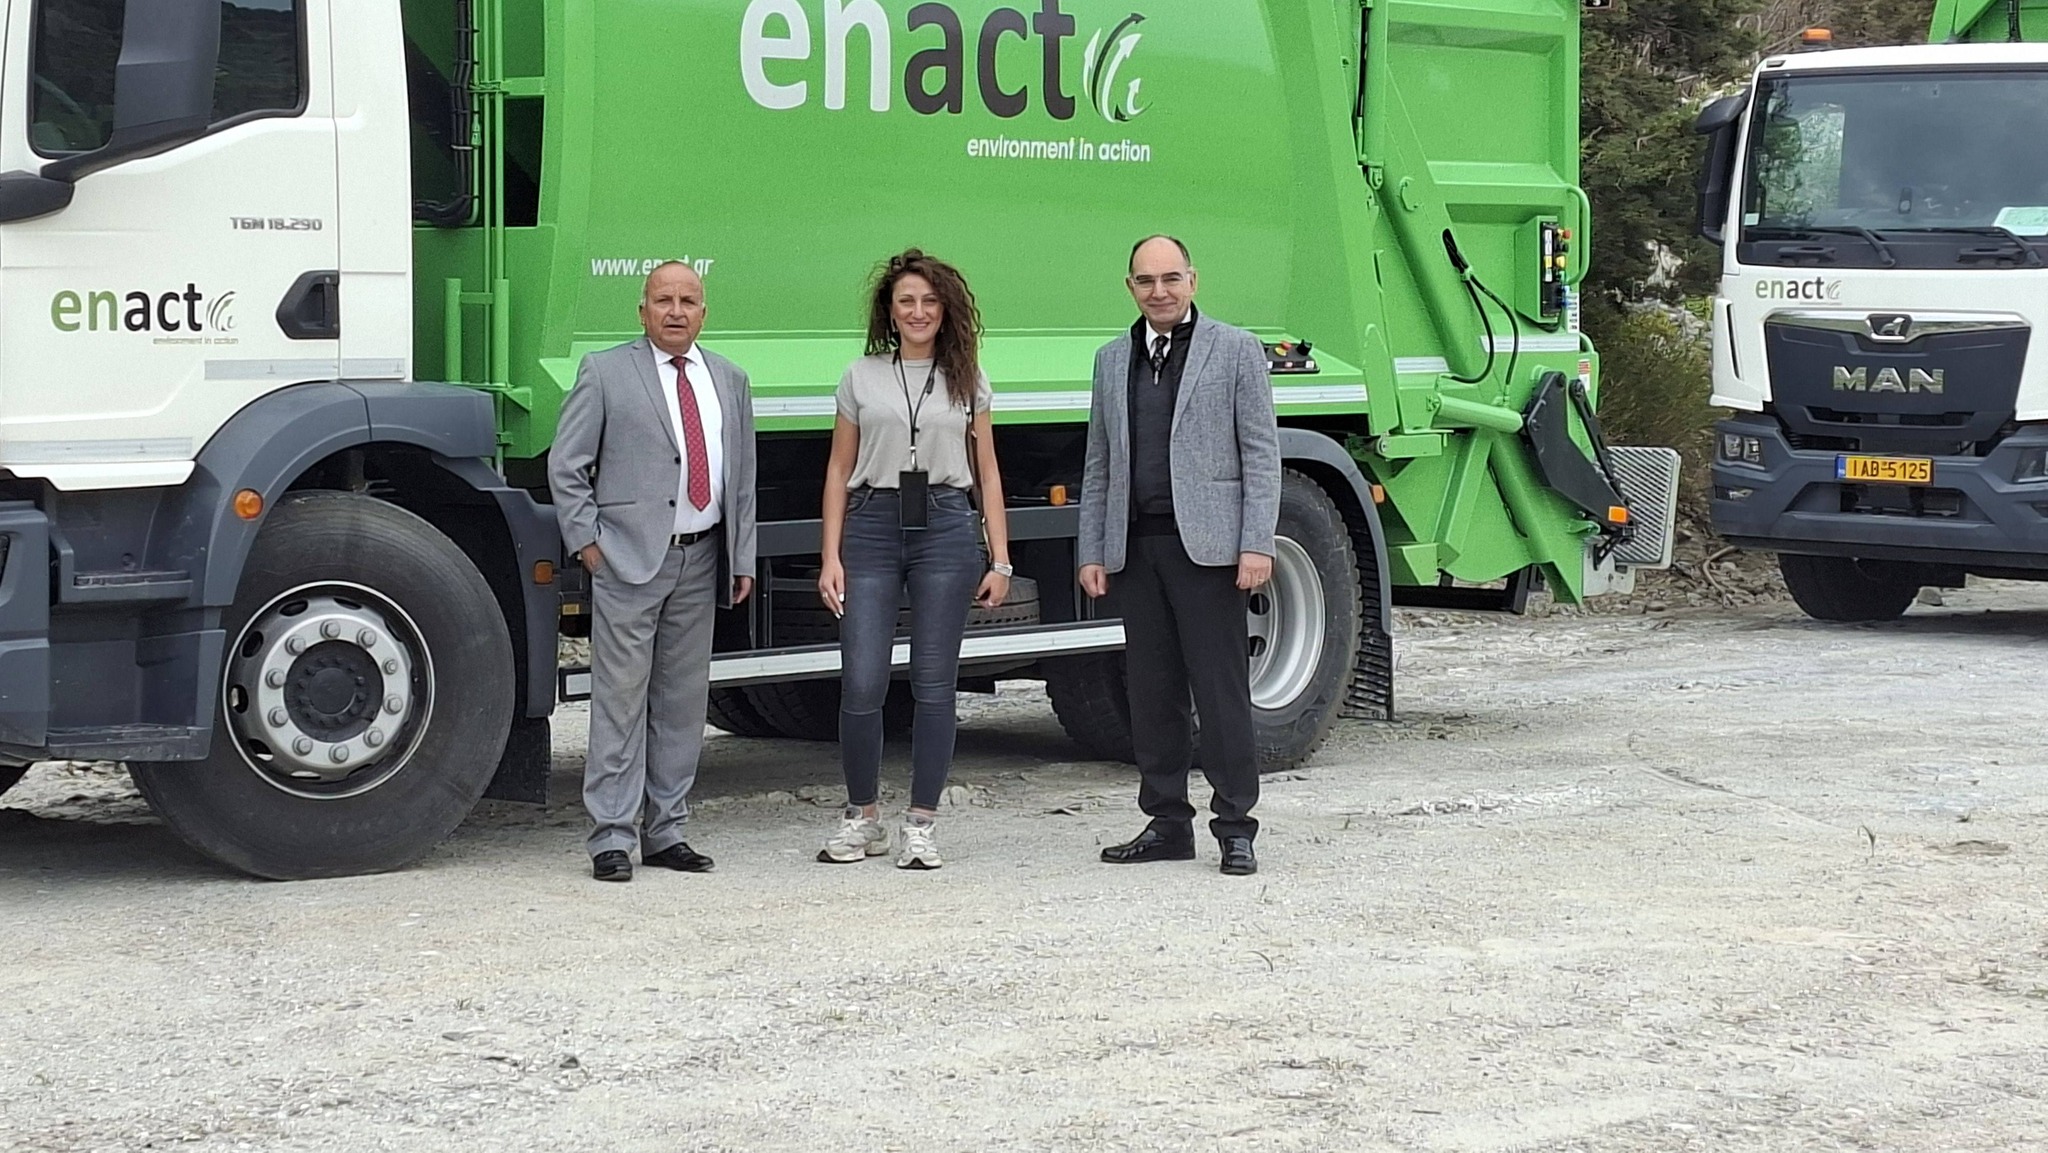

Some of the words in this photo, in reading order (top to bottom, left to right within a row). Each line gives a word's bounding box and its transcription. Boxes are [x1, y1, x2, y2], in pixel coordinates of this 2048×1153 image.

[740, 0, 1076, 120] enact
[967, 134, 1075, 160] environment
[1079, 137, 1094, 160] in
[1098, 139, 1151, 162] action
[591, 254, 715, 280] www.egr
[1755, 276, 1825, 299] enact
[51, 283, 203, 332] enact
[1833, 366, 1944, 394] MAN
